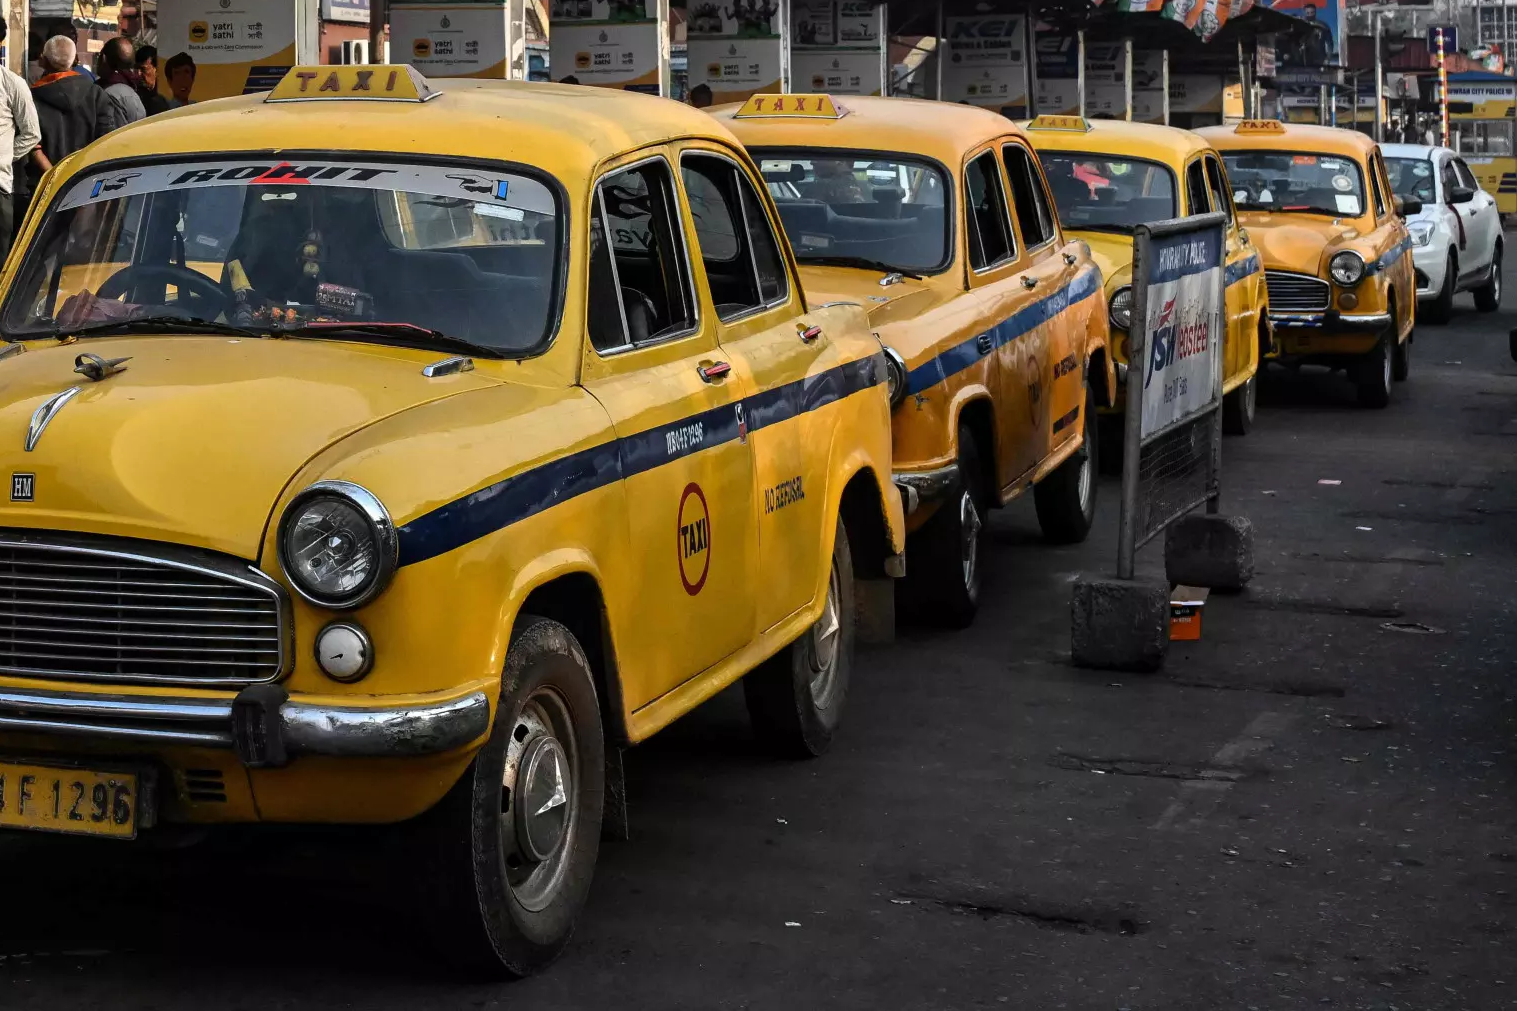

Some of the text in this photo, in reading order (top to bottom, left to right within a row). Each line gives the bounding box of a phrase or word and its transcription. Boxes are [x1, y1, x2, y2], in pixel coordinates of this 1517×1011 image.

[212, 22, 233, 32] yatri
[212, 31, 234, 39] sathi
[953, 19, 1017, 39] KEI
[295, 69, 398, 92] TAXI
[1471, 87, 1505, 95] CITY POLICE
[754, 97, 824, 112] TAXI
[1039, 118, 1079, 127] TAXI
[1242, 121, 1279, 129] TAXI
[171, 163, 400, 185] ROHIT
[1190, 240, 1207, 265] POLICE
[13, 477, 32, 497] HM
[764, 488, 774, 515] NO
[680, 517, 708, 559] TAXI
